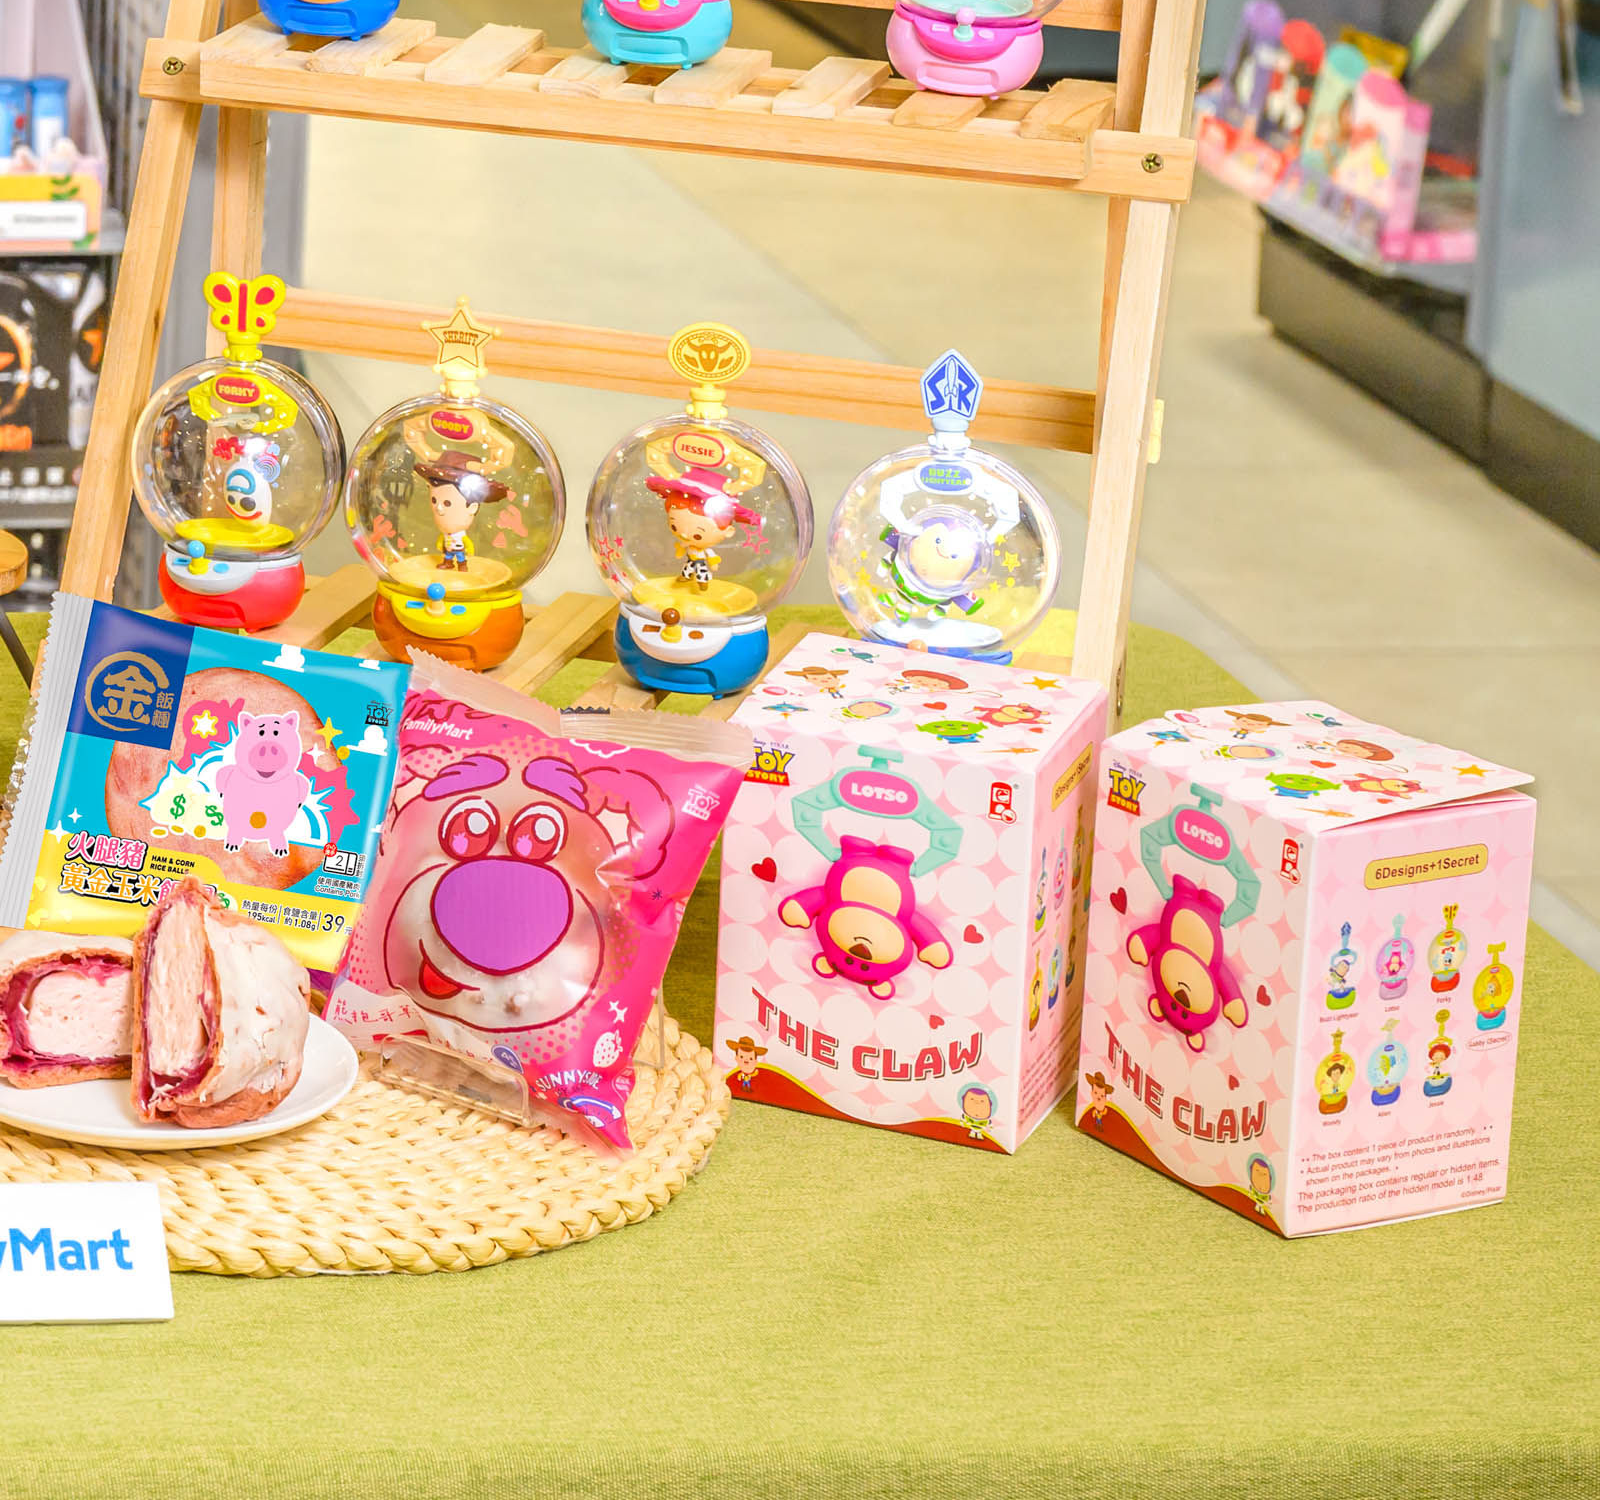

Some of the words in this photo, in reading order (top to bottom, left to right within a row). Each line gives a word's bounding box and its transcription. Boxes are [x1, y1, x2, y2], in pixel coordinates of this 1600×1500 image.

[443, 330, 479, 346] SHERIFF
[681, 444, 715, 458] JESSIE
[97, 666, 155, 725] 金
[151, 691, 175, 729] 飯糰
[367, 704, 394, 719] TOY
[402, 717, 474, 741] FamilyMart
[745, 770, 787, 784] STORY
[1108, 767, 1146, 800] TOY
[687, 789, 721, 811] TOY
[850, 782, 909, 804] LOTSO
[1181, 820, 1224, 850] LOTSO
[68, 831, 145, 869] 火腿豬
[151, 855, 168, 864] HAM
[175, 859, 195, 868] CORN
[335, 856, 343, 867] 2
[150, 863, 166, 872] RICE
[1374, 852, 1481, 881] 6Designs+1Secret
[314, 885, 343, 897] Contains
[242, 900, 278, 914] 熱量每份
[283, 907, 318, 920] 食鹽含量
[247, 911, 275, 924] 195kcal
[751, 986, 839, 1069] THE
[851, 1031, 984, 1083] CLAW
[536, 1069, 603, 1093] SUNNYSIDE
[1105, 1021, 1164, 1121] THE
[1172, 1099, 1267, 1144] CLAW
[1307, 1165, 1330, 1174] Actual
[1331, 1159, 1358, 1172] product
[1360, 1157, 1375, 1166] may
[1377, 1154, 1393, 1164] vary
[1394, 1151, 1409, 1160] from
[1411, 1146, 1435, 1158] photos
[1437, 1143, 1451, 1152] and
[1452, 1136, 1491, 1149] illustrations
[1312, 1153, 1326, 1162] The
[1327, 1150, 1341, 1160] box
[1398, 1139, 1407, 1147] of
[1407, 1134, 1434, 1147] product
[1298, 1191, 1314, 1200] The
[1315, 1182, 1357, 1198] packaging
[1358, 1181, 1374, 1191] box
[1375, 1175, 1409, 1187] contains
[1410, 1170, 1439, 1182] regular
[1440, 1167, 1449, 1176] or
[1450, 1161, 1477, 1173] hidden
[1331, 1174, 1341, 1182] on
[1342, 1171, 1354, 1180] the
[1297, 1204, 1313, 1213] The
[1315, 1196, 1357, 1212] production
[1358, 1193, 1377, 1203] ratio
[1378, 1190, 1387, 1198] of
[1388, 1188, 1401, 1197] the
[1402, 1183, 1430, 1195] hidden
[1431, 1178, 1456, 1190] model
[1457, 1177, 1464, 1185] is
